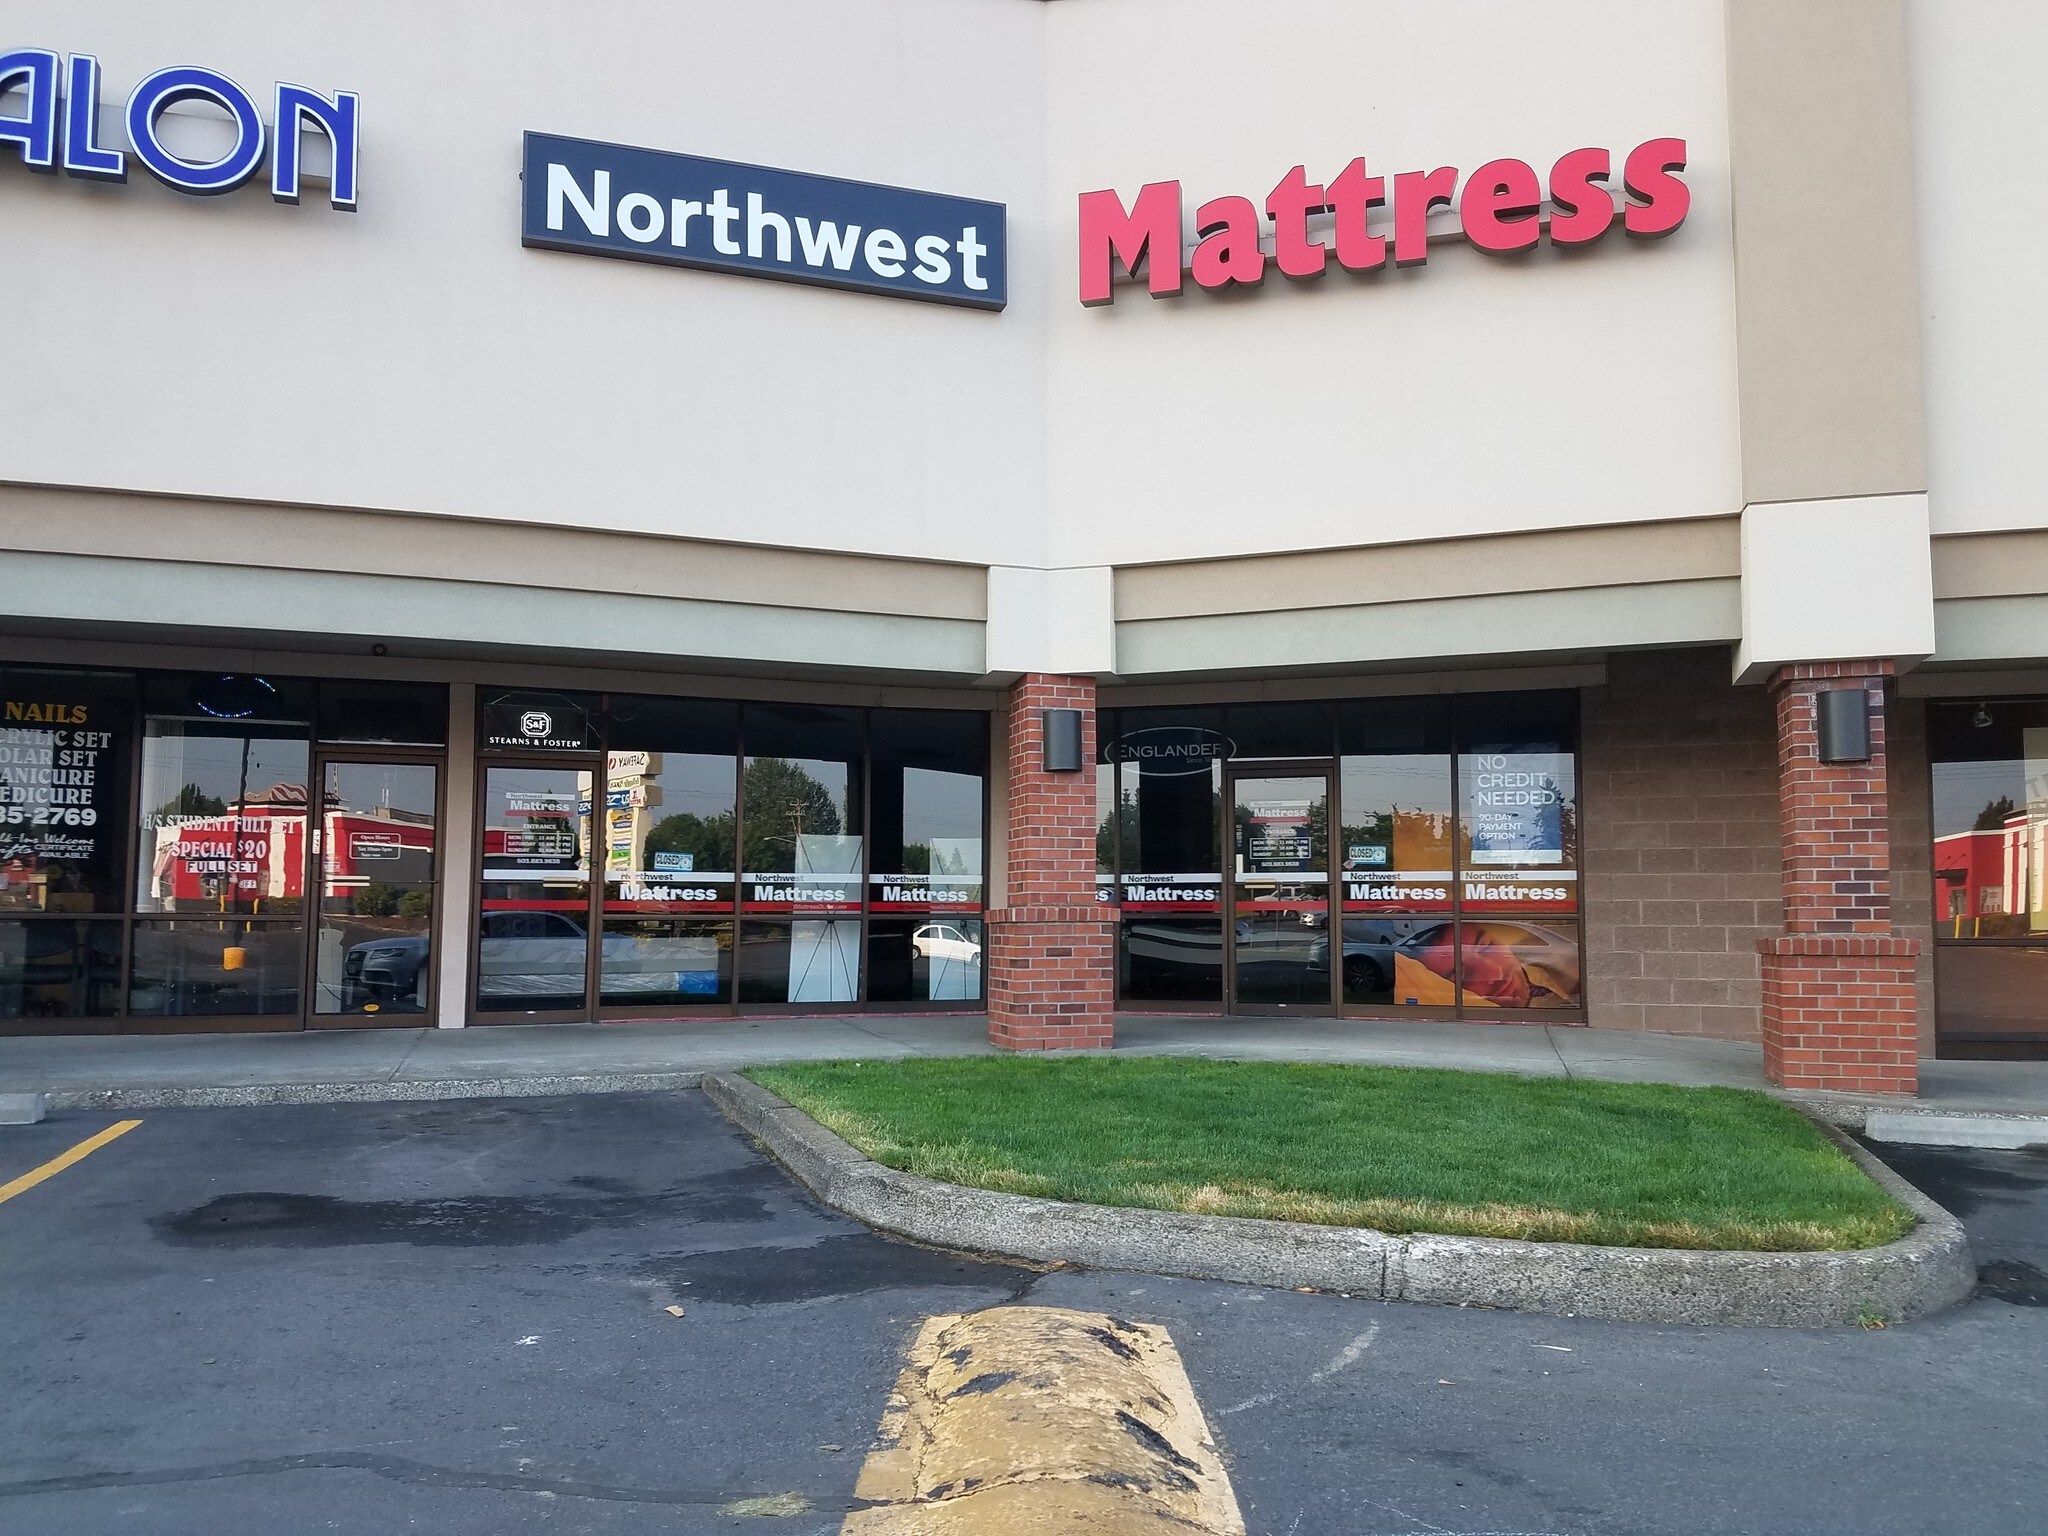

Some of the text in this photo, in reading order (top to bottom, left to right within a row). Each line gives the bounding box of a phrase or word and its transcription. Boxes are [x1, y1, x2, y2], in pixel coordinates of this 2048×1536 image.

[546, 162, 988, 290] Northwest
[1079, 137, 1690, 306] Mattress
[5, 702, 88, 724] NAILS
[526, 720, 546, 730] S&F
[73, 731, 111, 748] SET
[489, 737, 530, 745] STEARNS
[58, 750, 98, 767] SET
[1478, 755, 1507, 770] NO
[0, 767, 94, 785] ANICURE
[1477, 772, 1547, 788] CREDIT
[1478, 791, 1556, 806] NEEDED
[510, 800, 570, 812] Mattress
[1254, 808, 1307, 818] Mattress
[1478, 813, 1513, 822] 90-DAY
[166, 814, 231, 832] STUDENT
[234, 816, 268, 834] FULL
[1478, 822, 1523, 831] PAYMENT
[44, 833, 95, 844] Welcome
[1478, 832, 1516, 840] OPTION
[34, 844, 95, 852] CERTIFICATE
[171, 839, 267, 859] SPECIAL $20
[1350, 848, 1373, 858] CLOSED
[656, 854, 679, 865] CLOSED
[187, 861, 256, 872] FULL SET
[755, 874, 804, 882] Northwest
[883, 875, 930, 883] Northwest
[1127, 875, 1175, 883] Northwest
[1350, 872, 1402, 880] Northwest
[1465, 872, 1519, 880] Northwest
[620, 884, 718, 901] Mattress
[754, 885, 845, 902] Mattress
[883, 886, 968, 902] Mattress
[1127, 886, 1215, 901] Mattress
[1350, 883, 1447, 900] Mattress
[1465, 883, 1567, 900] Mattress
